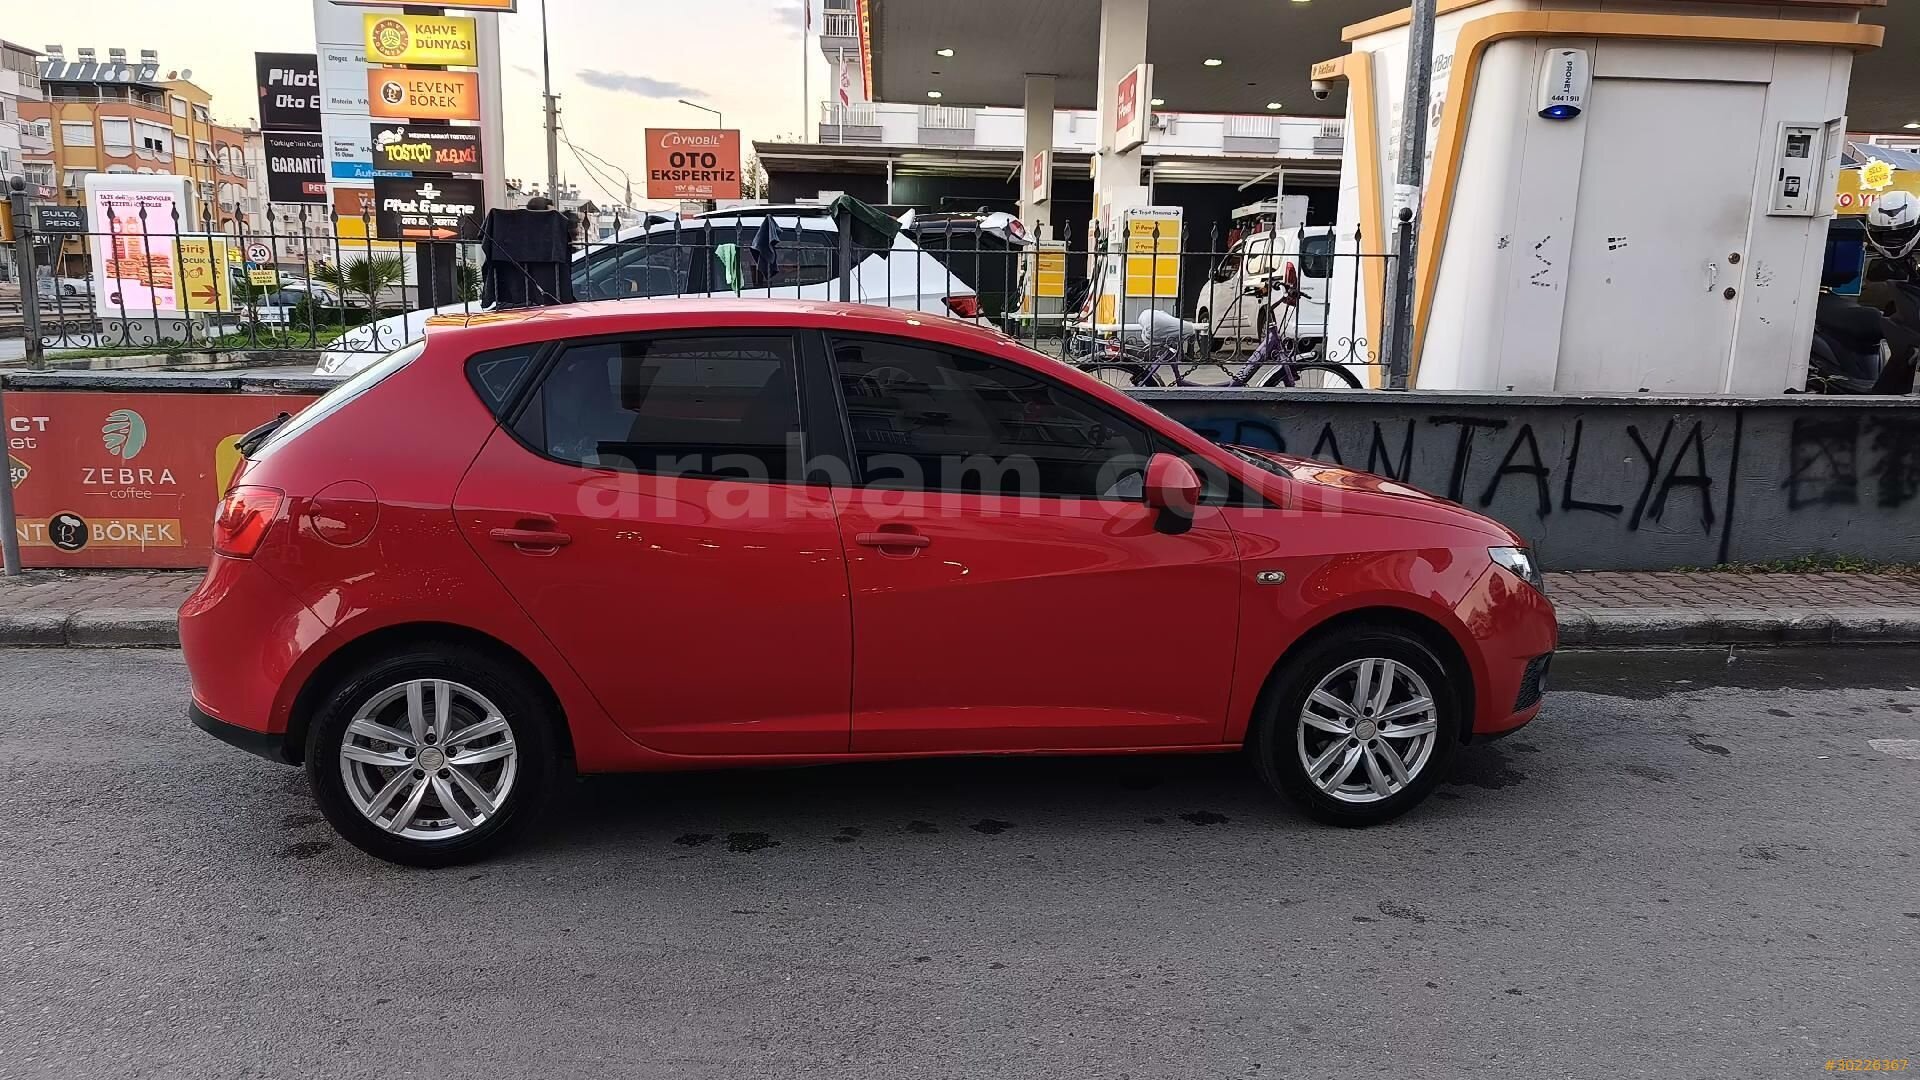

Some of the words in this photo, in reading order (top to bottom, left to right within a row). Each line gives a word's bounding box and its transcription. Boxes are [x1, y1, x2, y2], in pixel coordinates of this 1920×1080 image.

[415, 25, 457, 35] KAHVE
[415, 36, 471, 50] DÜNYASI
[268, 68, 318, 87] Pilot
[1563, 61, 1573, 93] PRONET
[409, 81, 464, 93] LEVENT
[276, 94, 305, 109] Oto
[309, 95, 320, 109] E
[410, 94, 456, 107] BÖREK
[669, 151, 717, 169] OTO
[651, 168, 735, 181] EKSPERTİZ
[42, 210, 82, 218] SULTA
[420, 200, 475, 217] Garage
[251, 249, 266, 257] 20
[82, 468, 177, 485] ZEBRA
[110, 487, 152, 499] coffee
[92, 520, 175, 541] BÖREK
